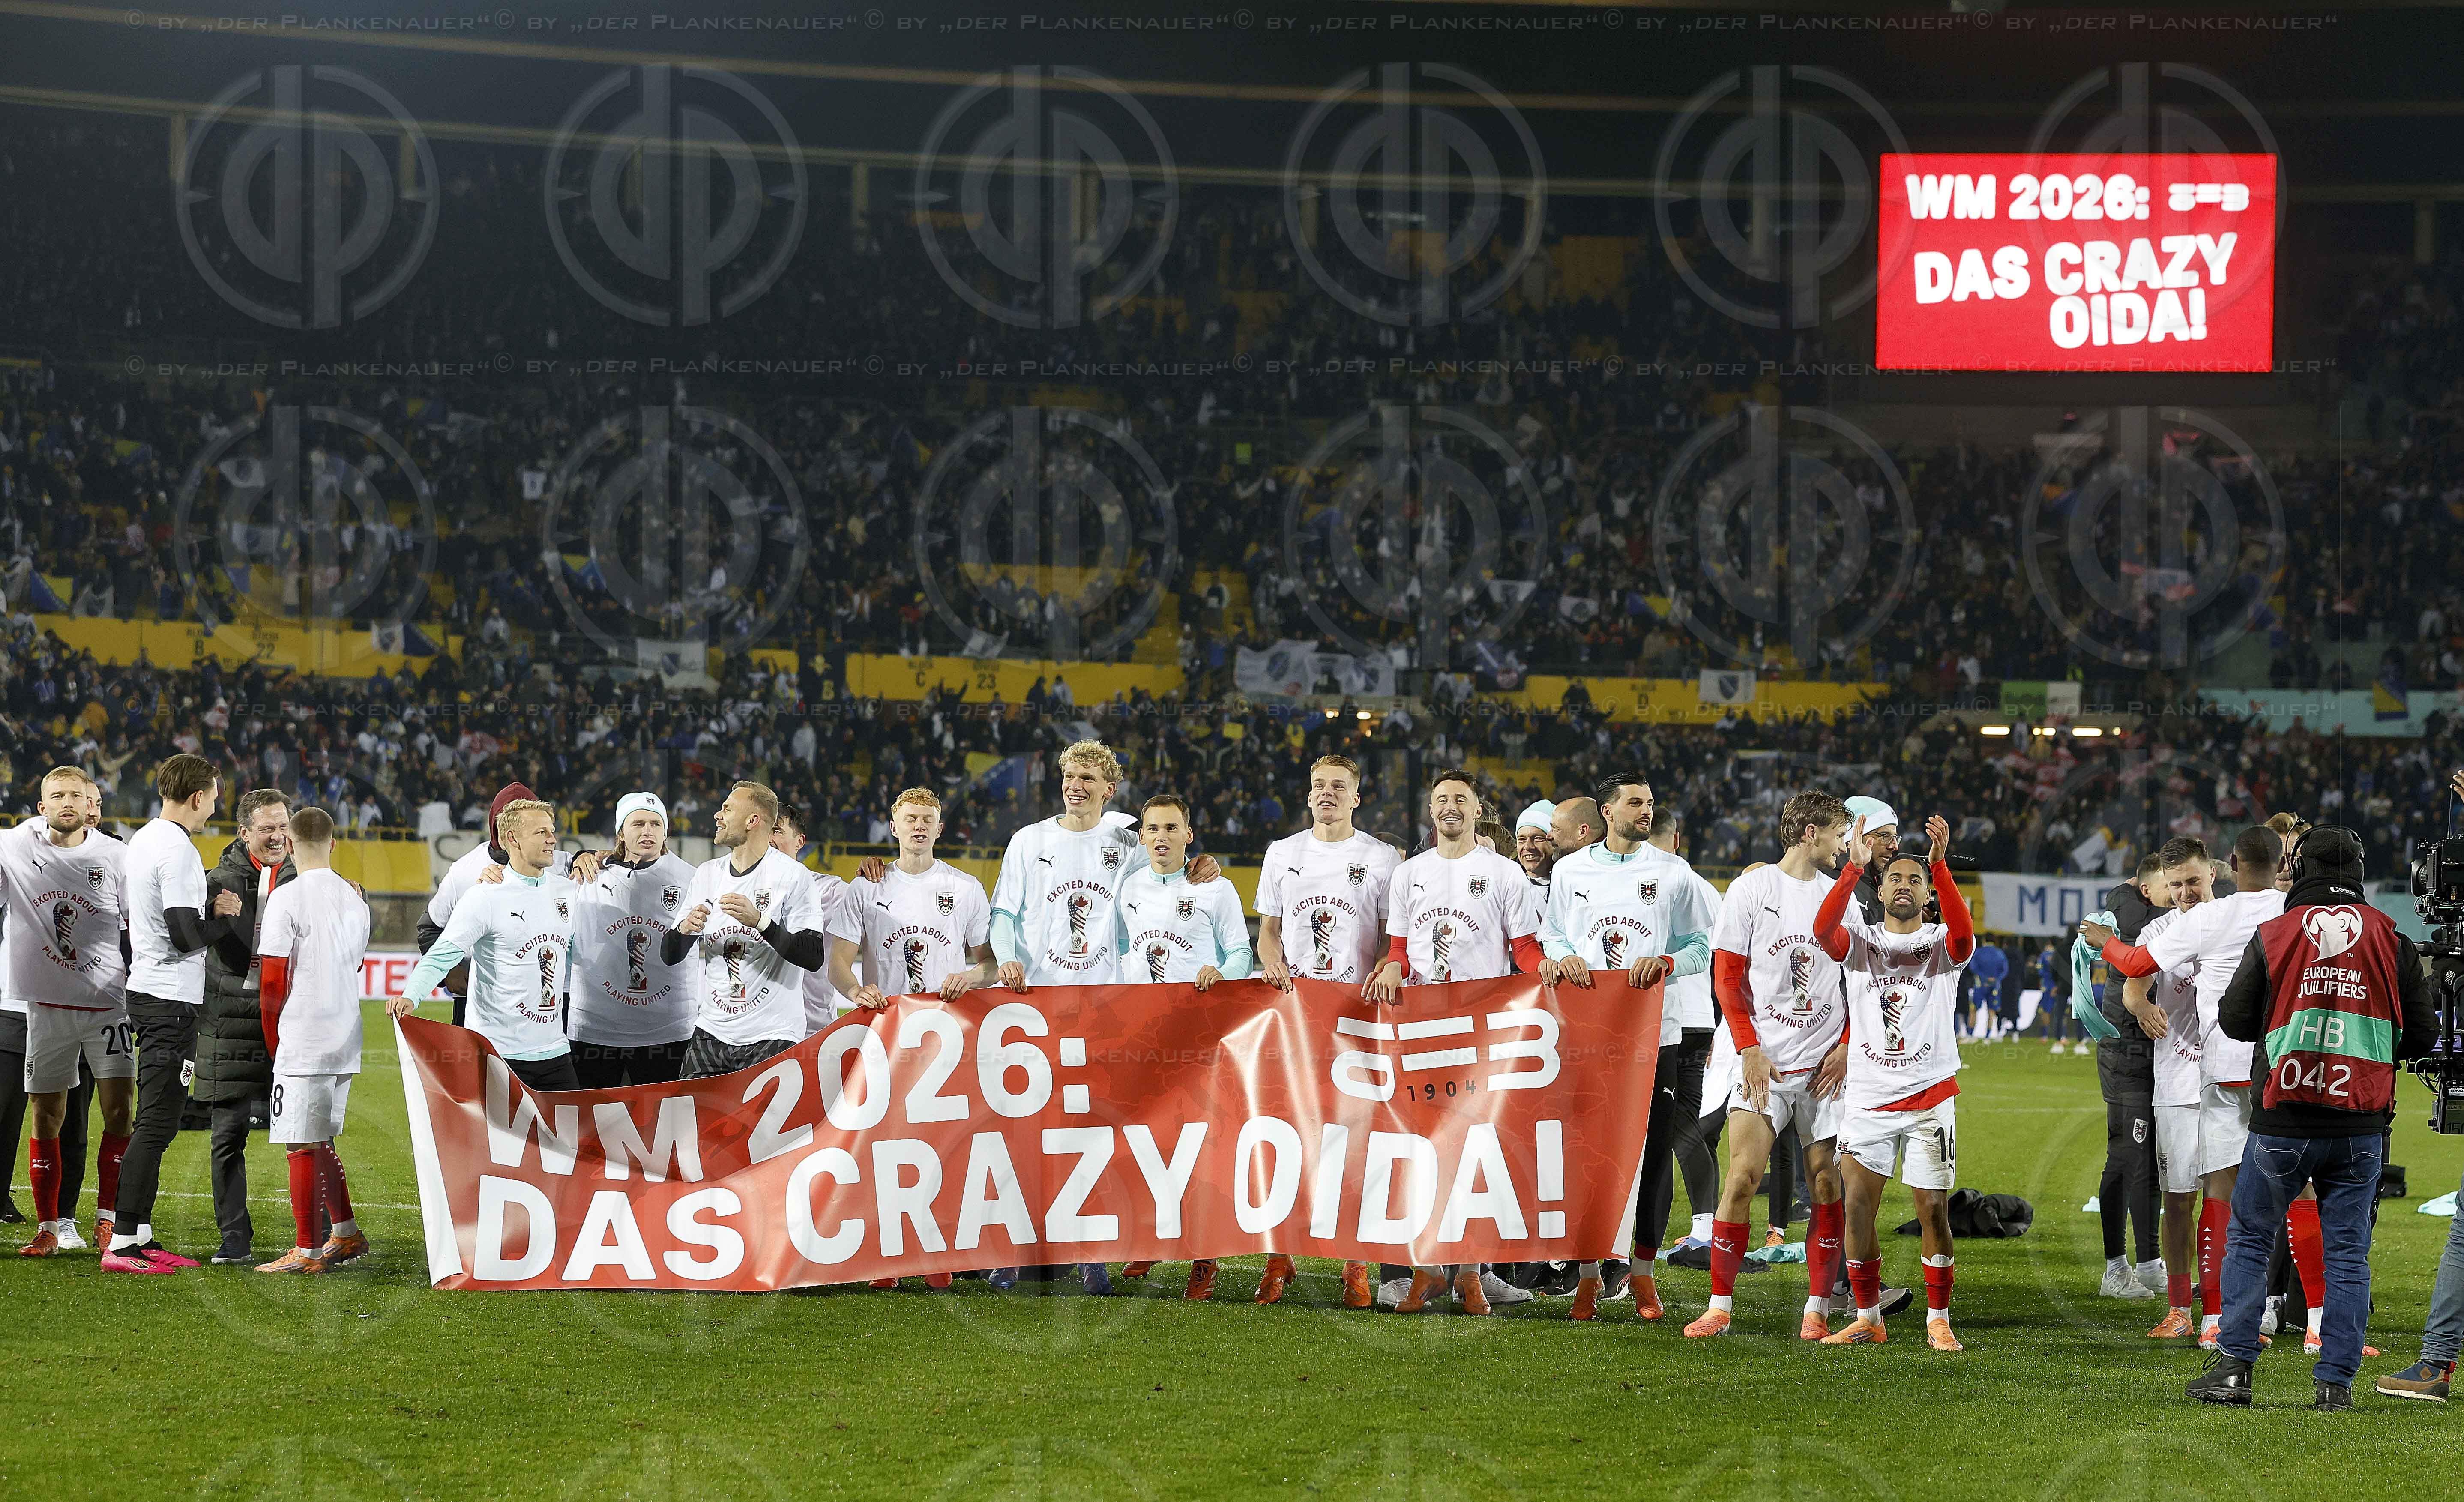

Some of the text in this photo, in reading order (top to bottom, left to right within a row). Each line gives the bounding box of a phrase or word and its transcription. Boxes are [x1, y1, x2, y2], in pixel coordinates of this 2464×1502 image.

[1905, 174, 1997, 220] WM
[2008, 173, 2150, 221] 2026:
[1914, 232, 2238, 305] DAS CRAZY
[2049, 287, 2208, 349] OIDA!
[33, 890, 100, 916] EXCITED ABOUT
[1046, 880, 1113, 903] EXCITED ABOUT
[1292, 896, 1327, 918] EXCITED
[1414, 907, 1480, 933] EXCITED ABOUT
[606, 916, 668, 936] EXCITED ABOU
[707, 925, 765, 948] EXCITED ABOUT
[882, 925, 951, 949] EXCITED ABOUT
[1587, 916, 1653, 941] EXCITED ABOUT
[515, 934, 567, 960] EXCITED ABOU
[1132, 929, 1193, 952] EXCITED ABOUT
[1767, 934, 1826, 957] EXCITED ABO
[42, 945, 101, 973] PLAYING NITD
[1046, 946, 1107, 971] PLAYING UNITED
[1289, 963, 1354, 983] PLAY ITED
[1866, 975, 1928, 993] EXCITED ABOUT
[2174, 974, 2195, 995] EXCI
[2303, 966, 2362, 983] EUROPEAN
[602, 980, 672, 1006] PLAYING UNITED
[712, 987, 769, 1014] PLAYING UNITED
[516, 1002, 548, 1024] PLAYING
[1765, 1002, 1833, 1029] PLAYING UNITED
[101, 1022, 133, 1056] 20
[2299, 1015, 2345, 1048] HB
[1860, 1042, 1931, 1068] PLAYING UNITED
[2174, 1041, 2201, 1062] PLAYIN
[1407, 1078, 1478, 1103] 1904
[2280, 1058, 2351, 1097] 042
[271, 1084, 284, 1117] 8
[486, 1053, 704, 1183] WM
[742, 1002, 1090, 1164] 2026:
[1933, 1125, 1955, 1162] 16
[473, 1115, 1567, 1281] DAS CRAZY OIDA!
